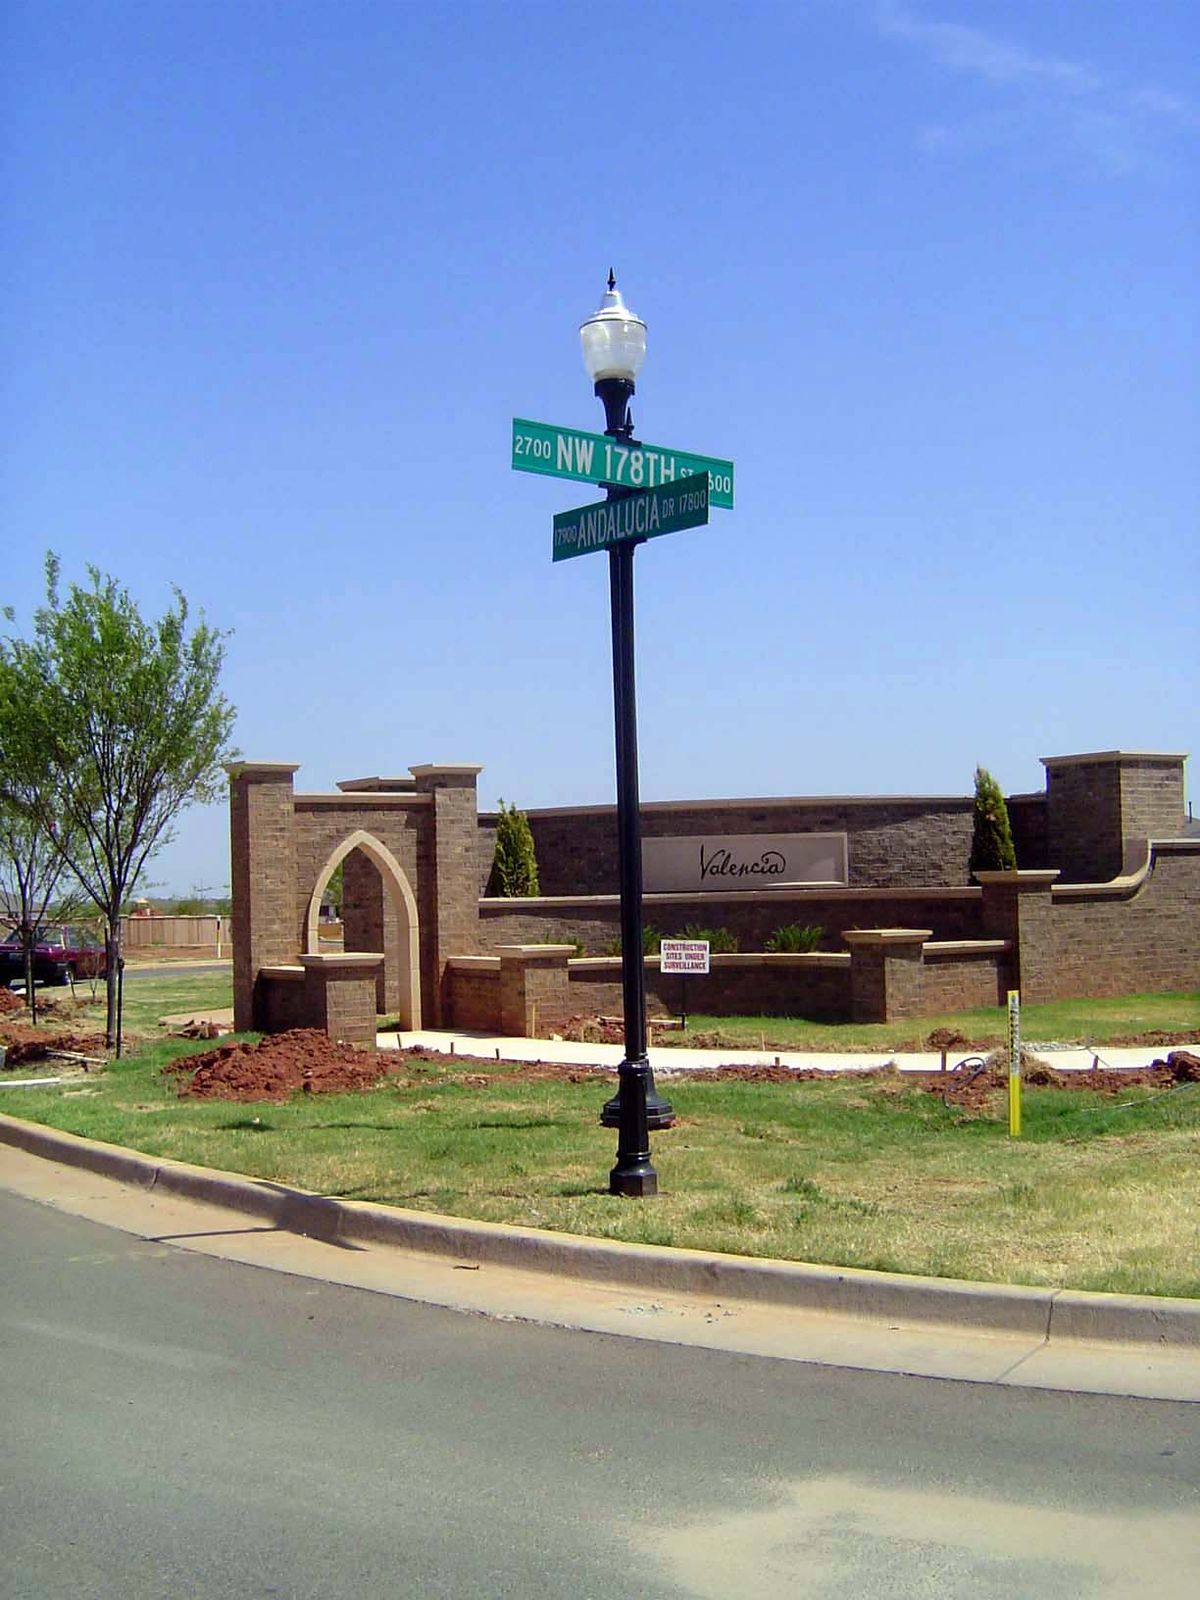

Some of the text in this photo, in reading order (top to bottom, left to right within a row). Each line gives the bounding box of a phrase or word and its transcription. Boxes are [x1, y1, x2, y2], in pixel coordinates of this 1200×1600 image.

[515, 435, 551, 459] 2700
[556, 434, 594, 475] NW
[604, 444, 675, 487] 178TH
[577, 494, 660, 549] ANDALUCIA
[662, 498, 674, 518] DR
[679, 490, 706, 514] 17800
[700, 844, 786, 880] Valencia
